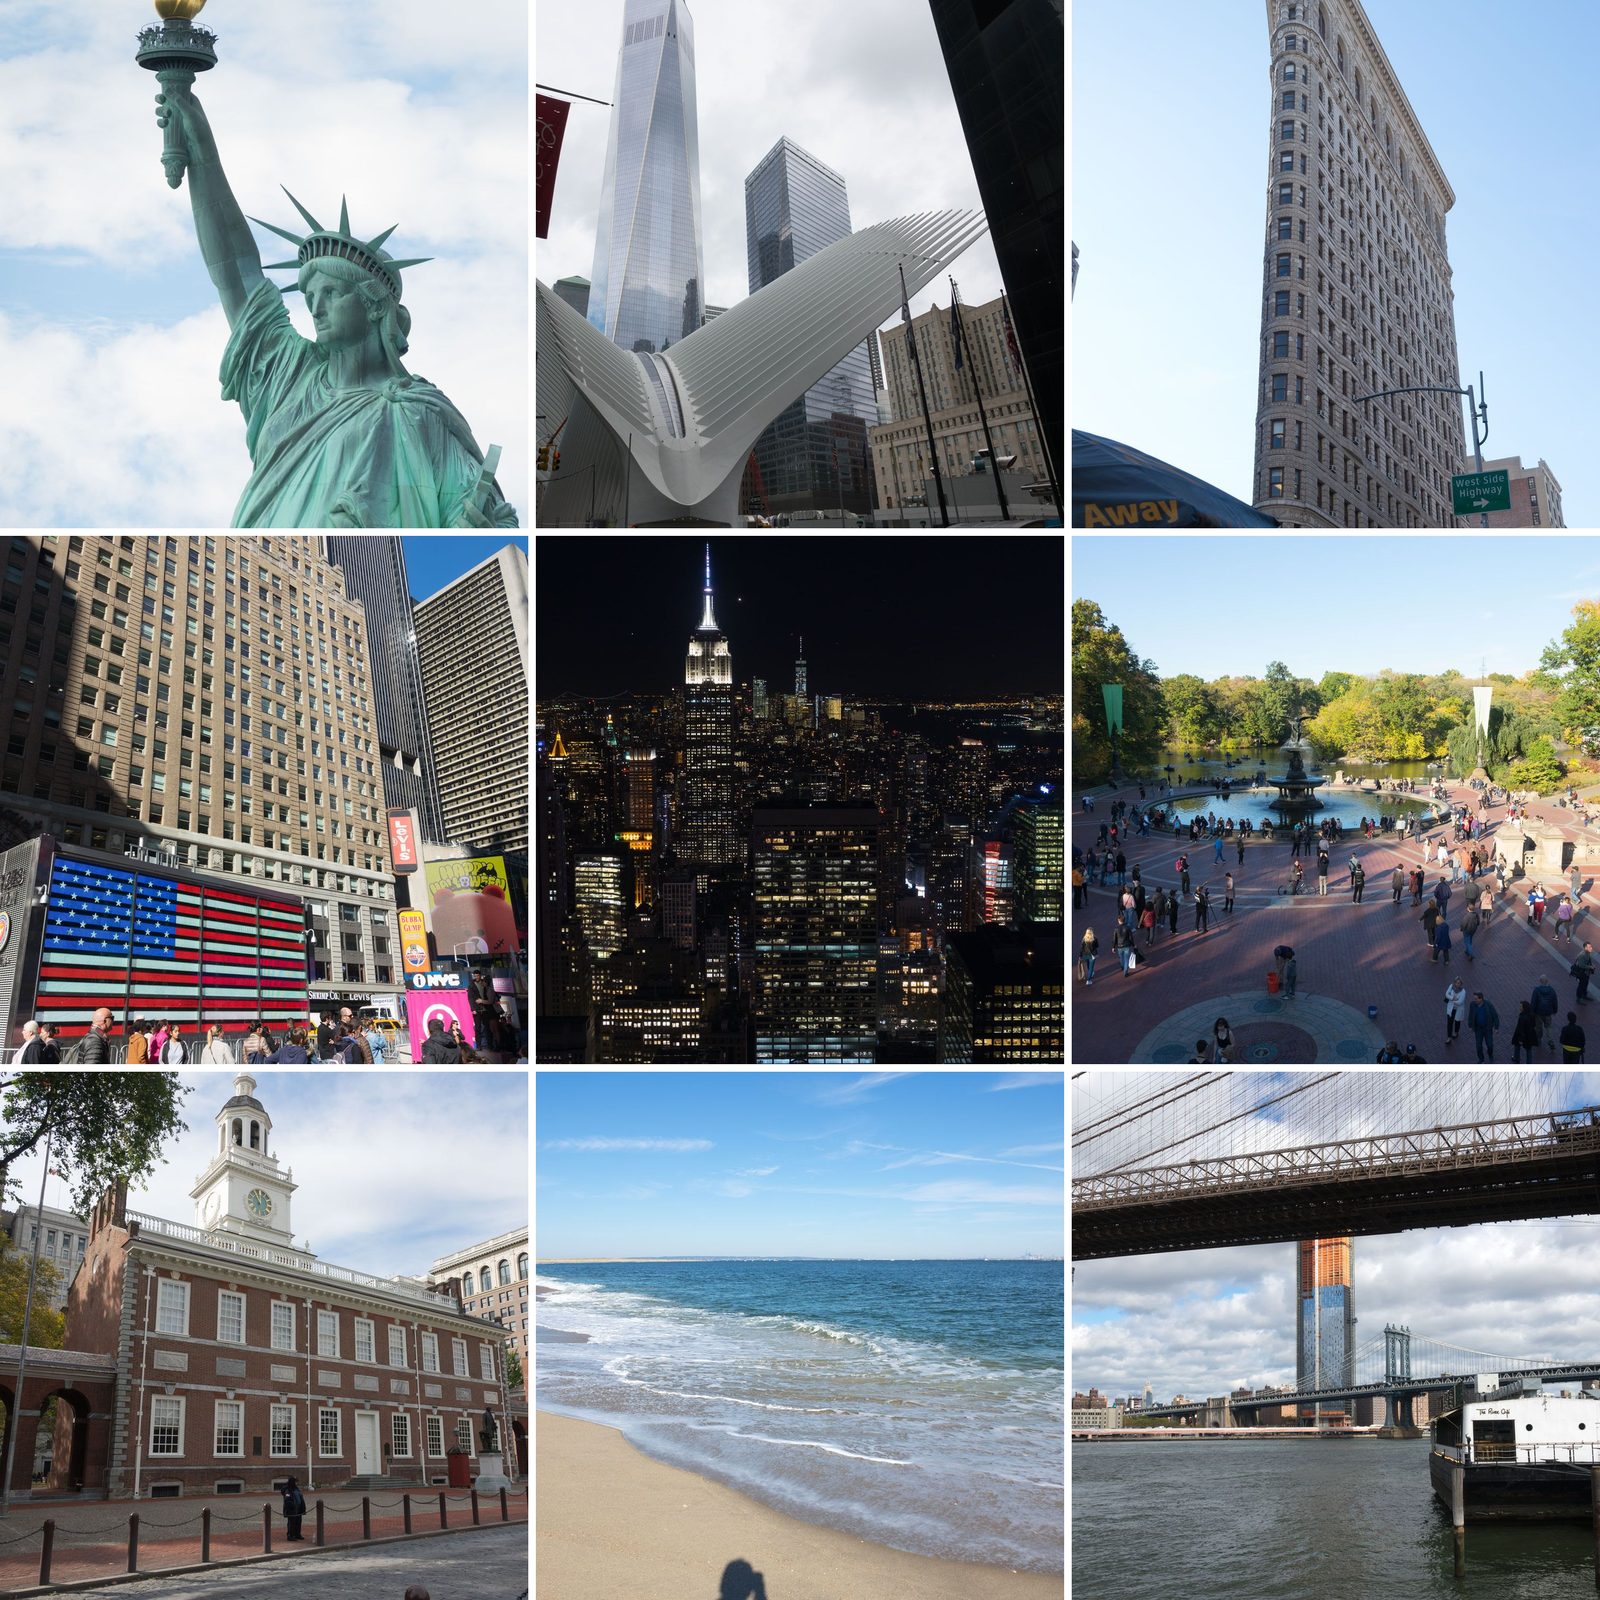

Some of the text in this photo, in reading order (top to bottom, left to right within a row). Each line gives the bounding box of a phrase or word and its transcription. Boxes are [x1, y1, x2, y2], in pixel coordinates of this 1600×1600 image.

[1455, 474, 1505, 487] West Side
[1459, 485, 1502, 498] Highway
[1084, 500, 1179, 528] Away
[403, 924, 422, 932] GUMP
[427, 973, 460, 987] NYC
[308, 990, 328, 1000] SHRIMP
